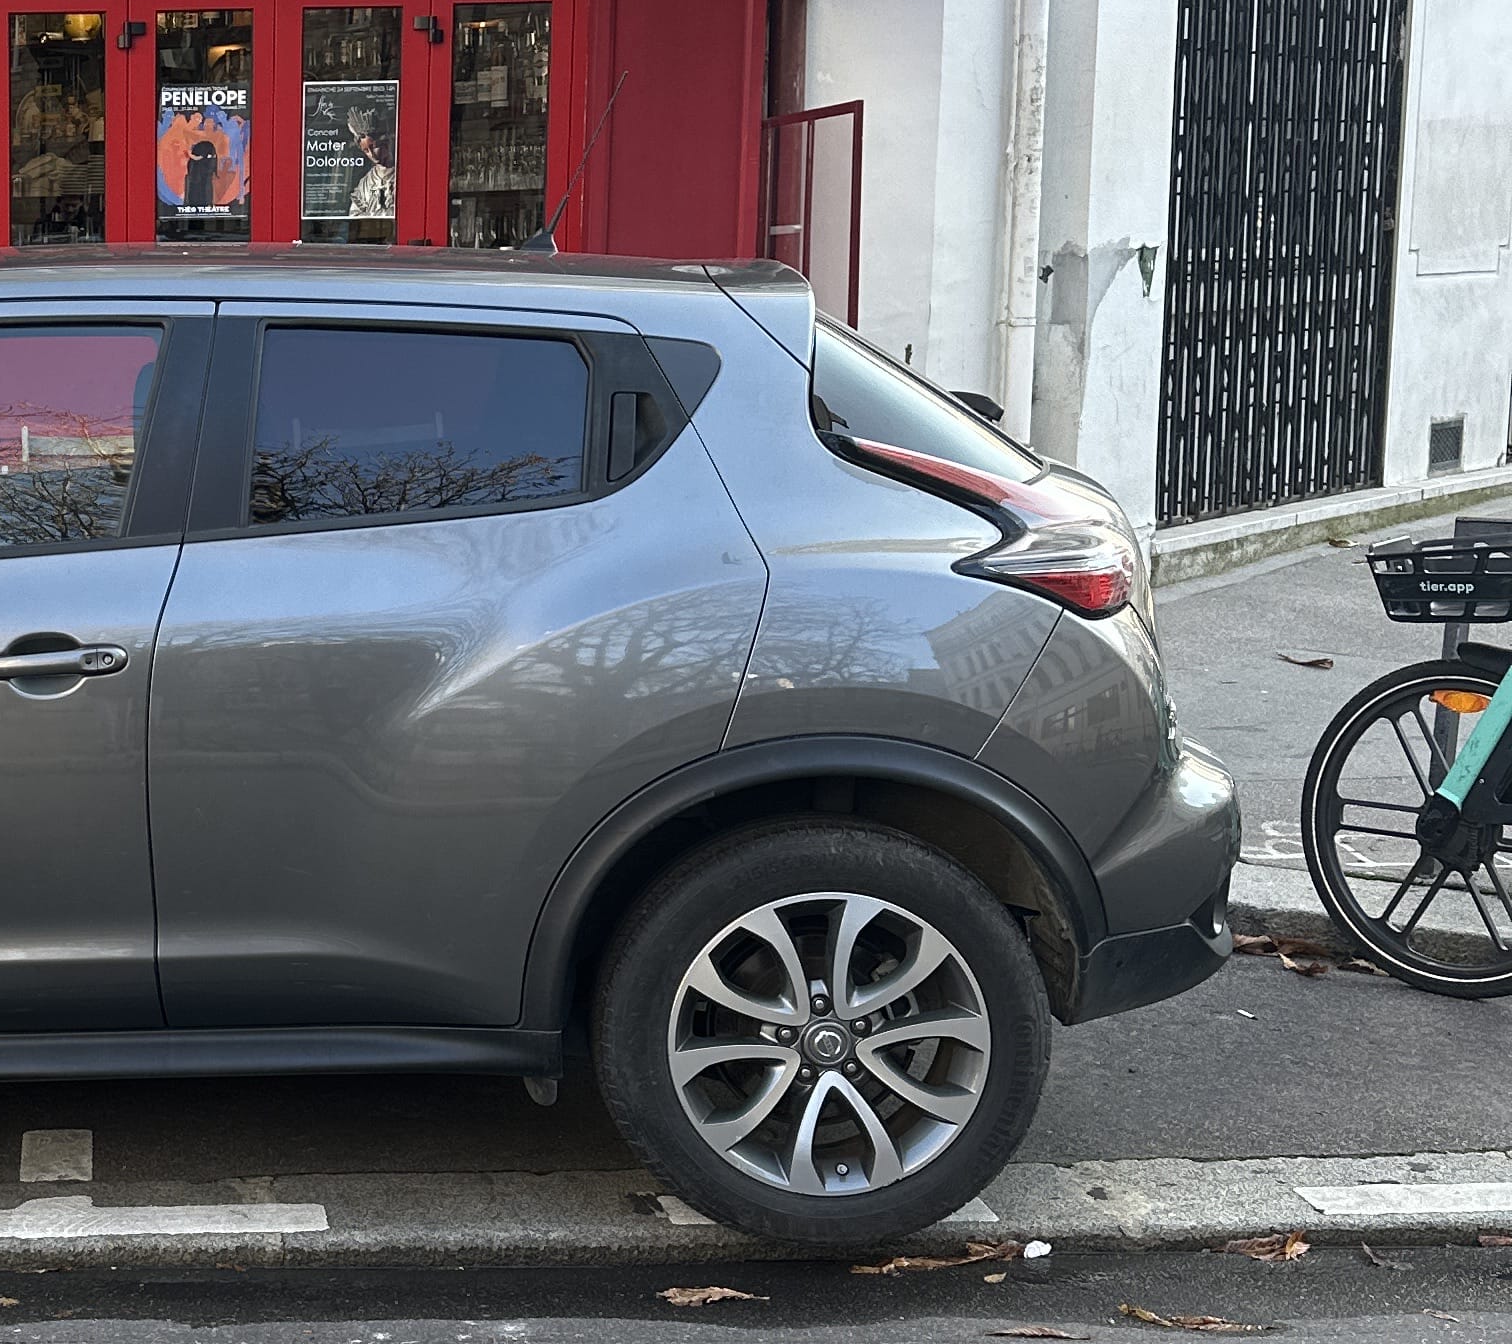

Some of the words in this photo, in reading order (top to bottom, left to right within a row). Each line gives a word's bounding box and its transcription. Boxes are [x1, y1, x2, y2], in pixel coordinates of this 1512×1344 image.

[161, 90, 247, 106] PENELOPE
[307, 128, 339, 137] Concert
[306, 140, 347, 152] Mater
[306, 156, 365, 167] Dolorosa
[1419, 581, 1475, 594] tier.app
